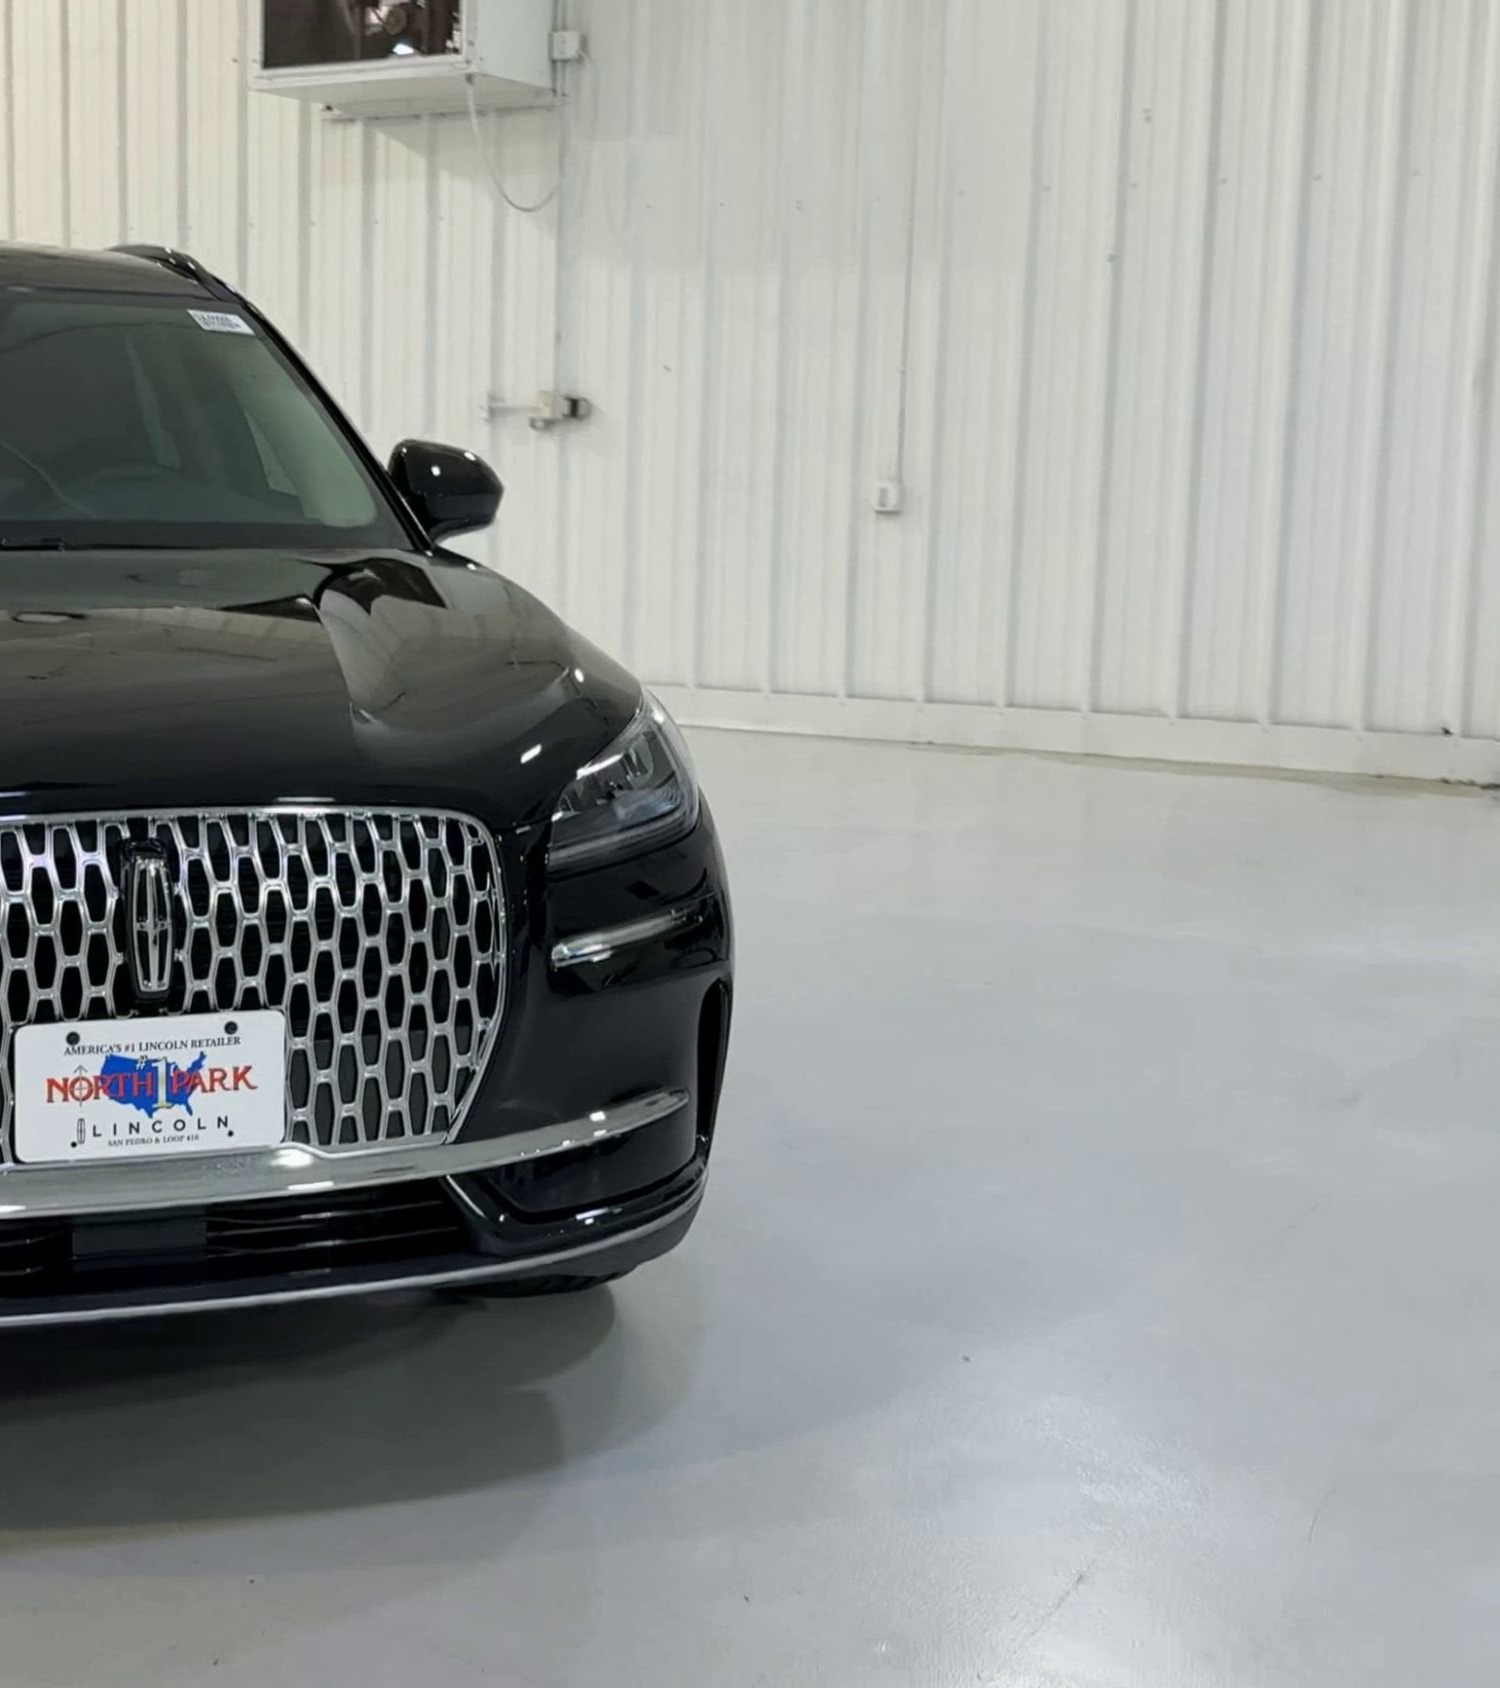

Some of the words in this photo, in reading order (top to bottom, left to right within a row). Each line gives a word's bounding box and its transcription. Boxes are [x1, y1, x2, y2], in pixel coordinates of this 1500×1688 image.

[64, 1043, 122, 1056] AMERICA'S
[124, 1043, 135, 1053] #1
[139, 1040, 188, 1052] LINCOLN
[191, 1036, 241, 1049] RETAILER
[46, 1071, 153, 1103] NORTH
[171, 1065, 258, 1096] PARK
[92, 1115, 228, 1138] LINCOLN
[108, 1138, 124, 1147] SAN
[125, 1137, 153, 1146] PEDRO
[155, 1136, 161, 1144] &
[163, 1134, 185, 1144] LOOP
